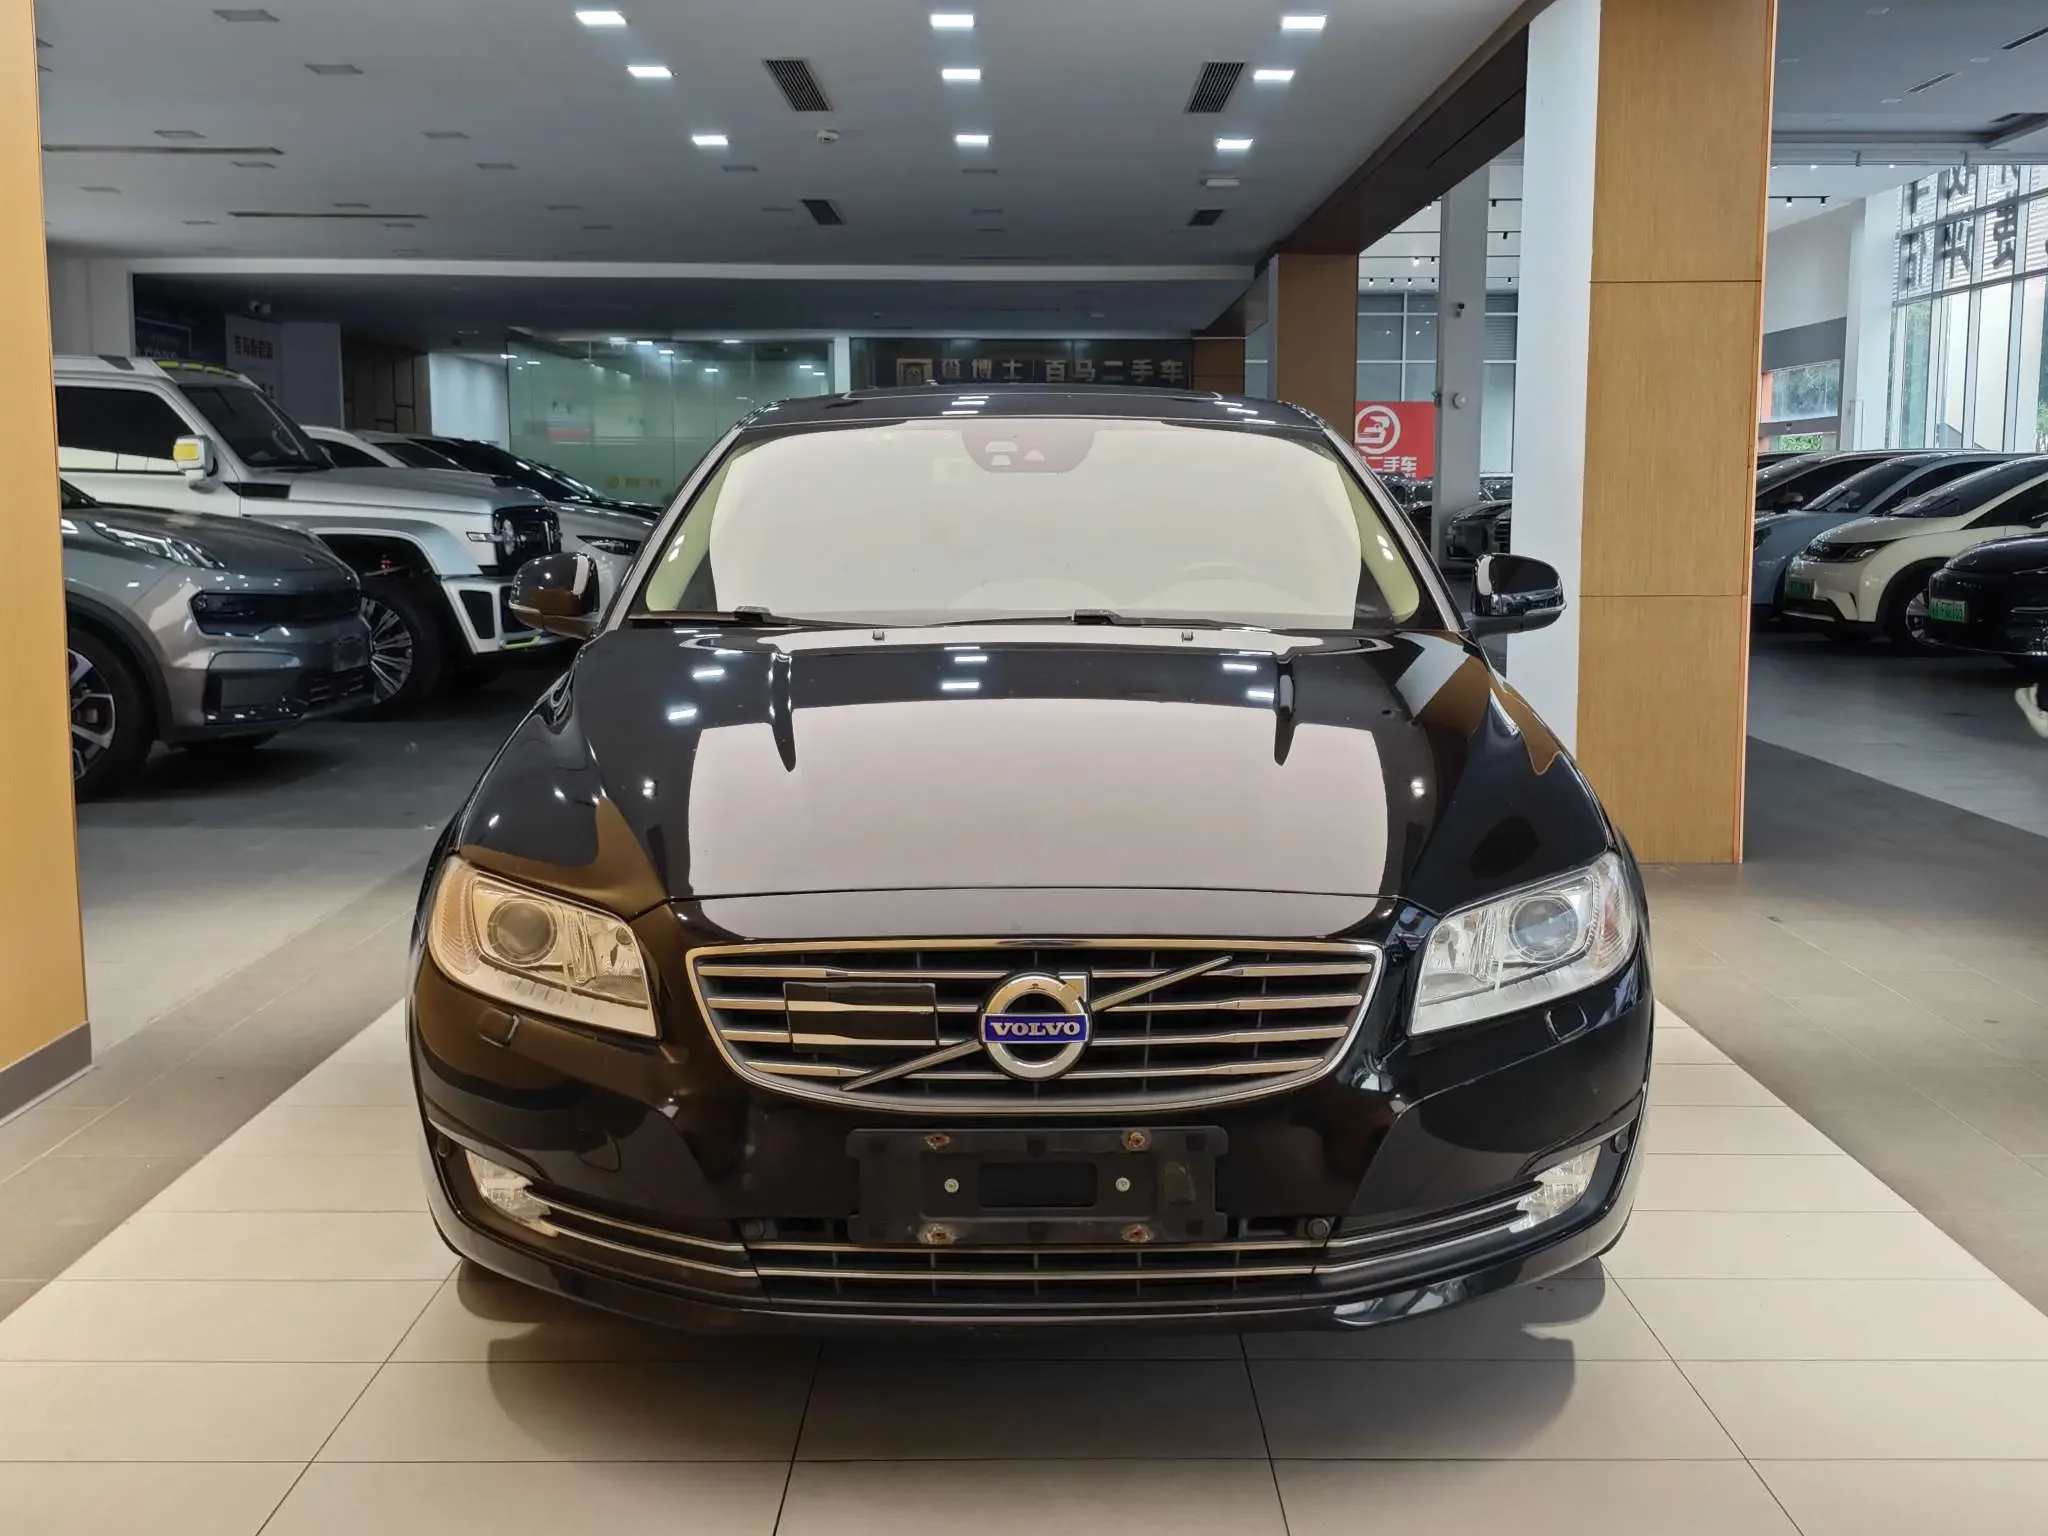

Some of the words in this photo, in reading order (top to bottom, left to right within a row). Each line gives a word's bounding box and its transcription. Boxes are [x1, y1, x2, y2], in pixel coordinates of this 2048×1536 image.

[1044, 358, 1184, 382] 百马二手车
[1362, 456, 1417, 472] 二手车
[990, 1022, 1081, 1035] VOLVO
